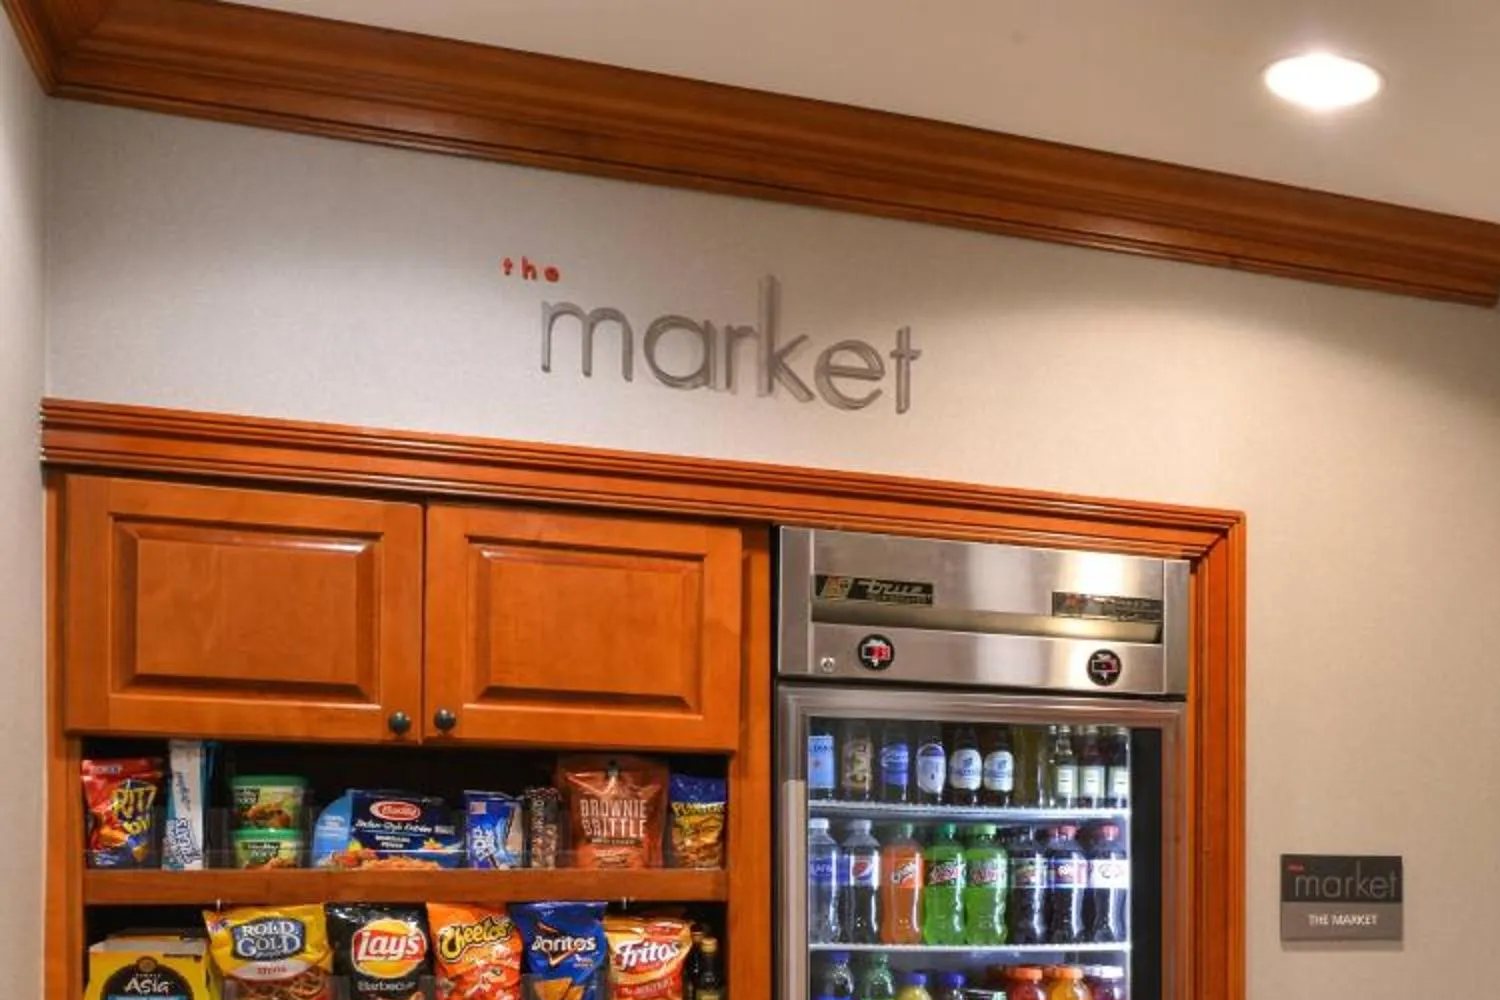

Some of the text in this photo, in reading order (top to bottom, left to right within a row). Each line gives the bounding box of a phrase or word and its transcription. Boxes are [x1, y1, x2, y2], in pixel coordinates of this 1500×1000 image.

[502, 256, 560, 283] the
[541, 274, 922, 414] market
[580, 799, 647, 818] BROWNIE
[582, 818, 647, 837] BRITTLE
[1295, 860, 1398, 898] market
[241, 921, 297, 937] ROLD
[1309, 914, 1378, 925] THE MARKET
[237, 933, 302, 957] GOLD
[440, 916, 514, 961] Cheetos
[531, 935, 597, 954] Doritos
[616, 940, 681, 969] Fritos
